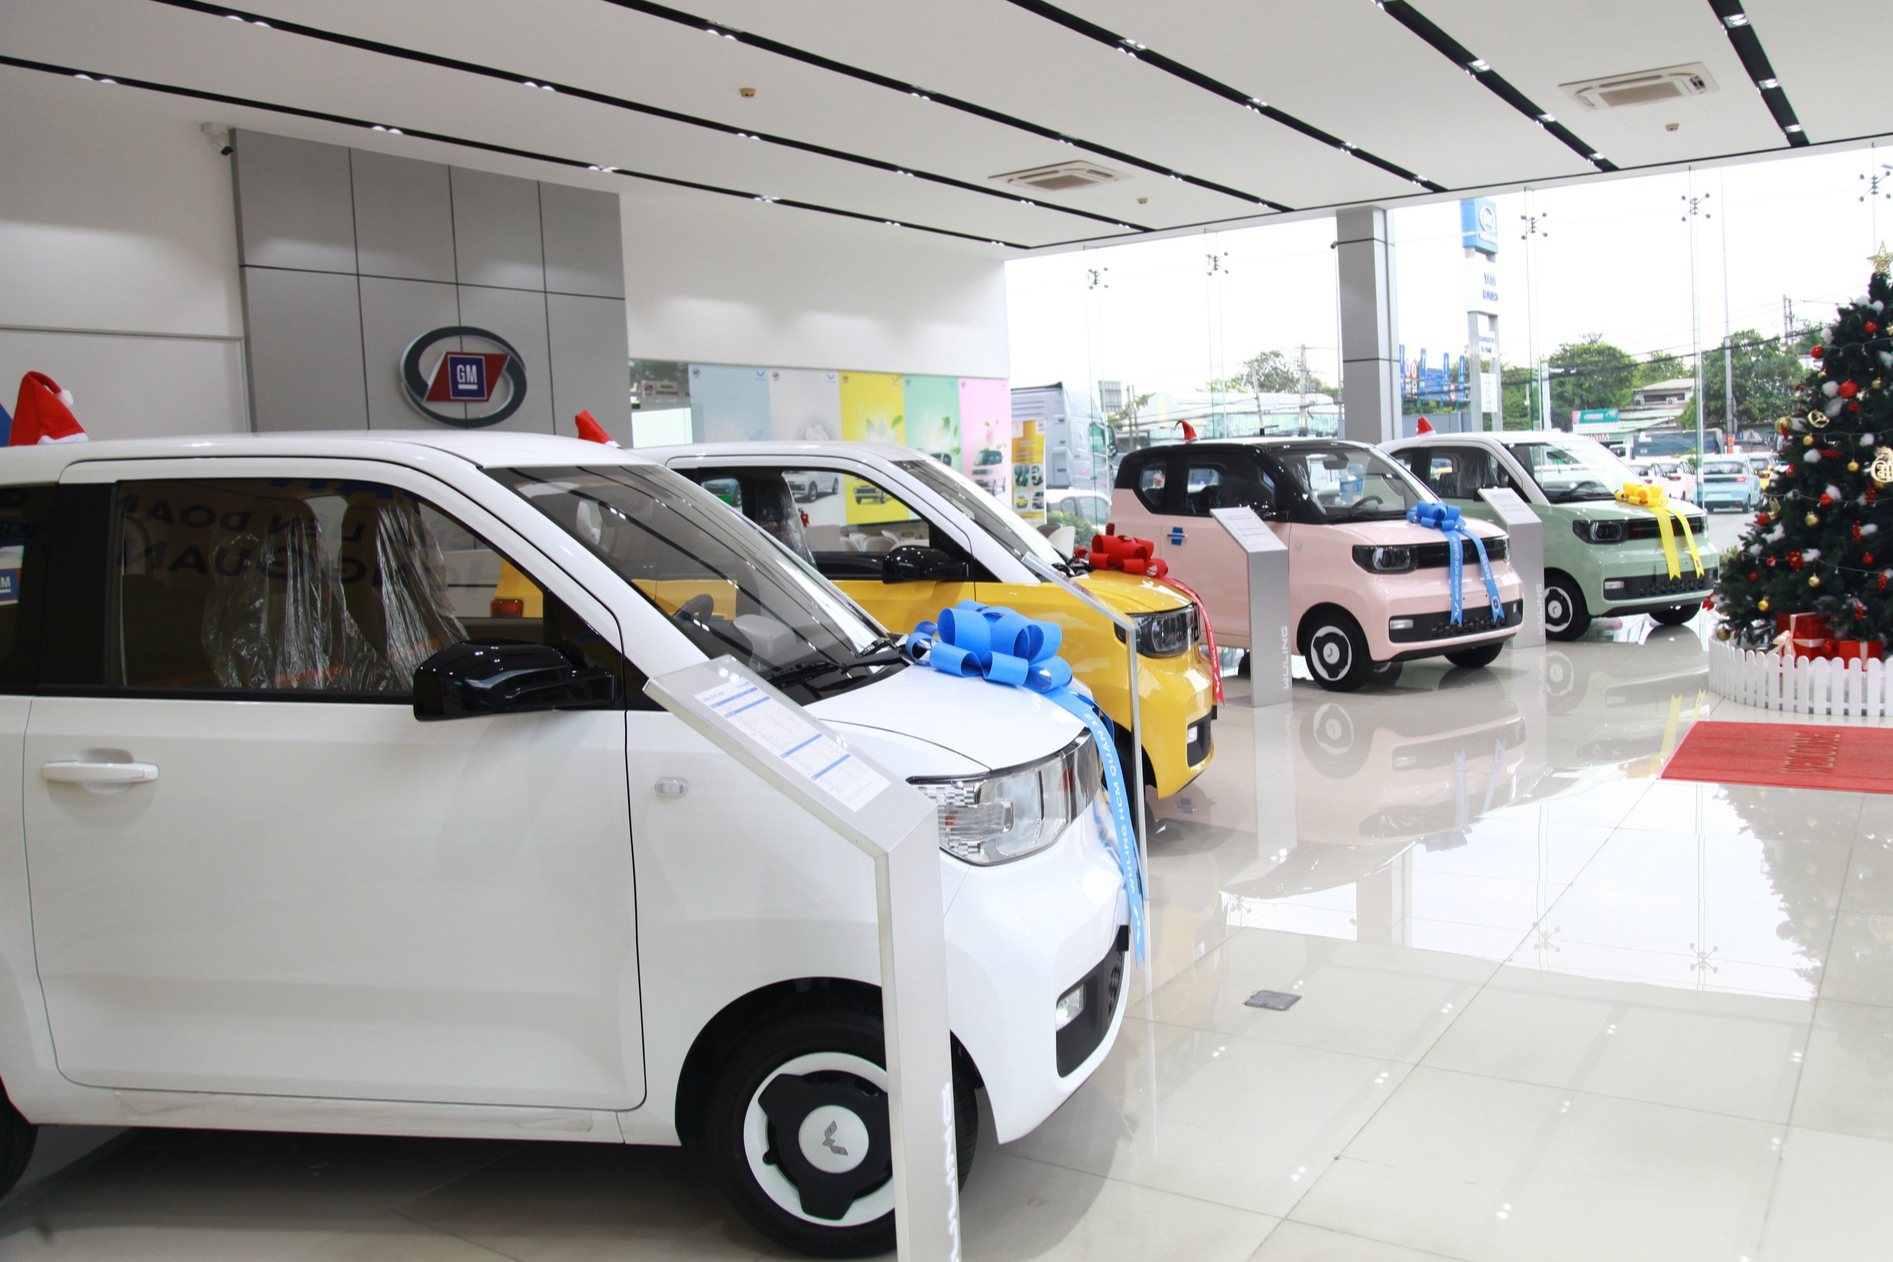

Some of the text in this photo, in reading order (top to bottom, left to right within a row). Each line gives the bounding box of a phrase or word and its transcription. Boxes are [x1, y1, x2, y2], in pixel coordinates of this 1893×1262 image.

[456, 364, 478, 383] GM
[1281, 625, 1290, 690] WULING
[1113, 780, 1126, 821] HCM
[1120, 824, 1136, 894] WULING
